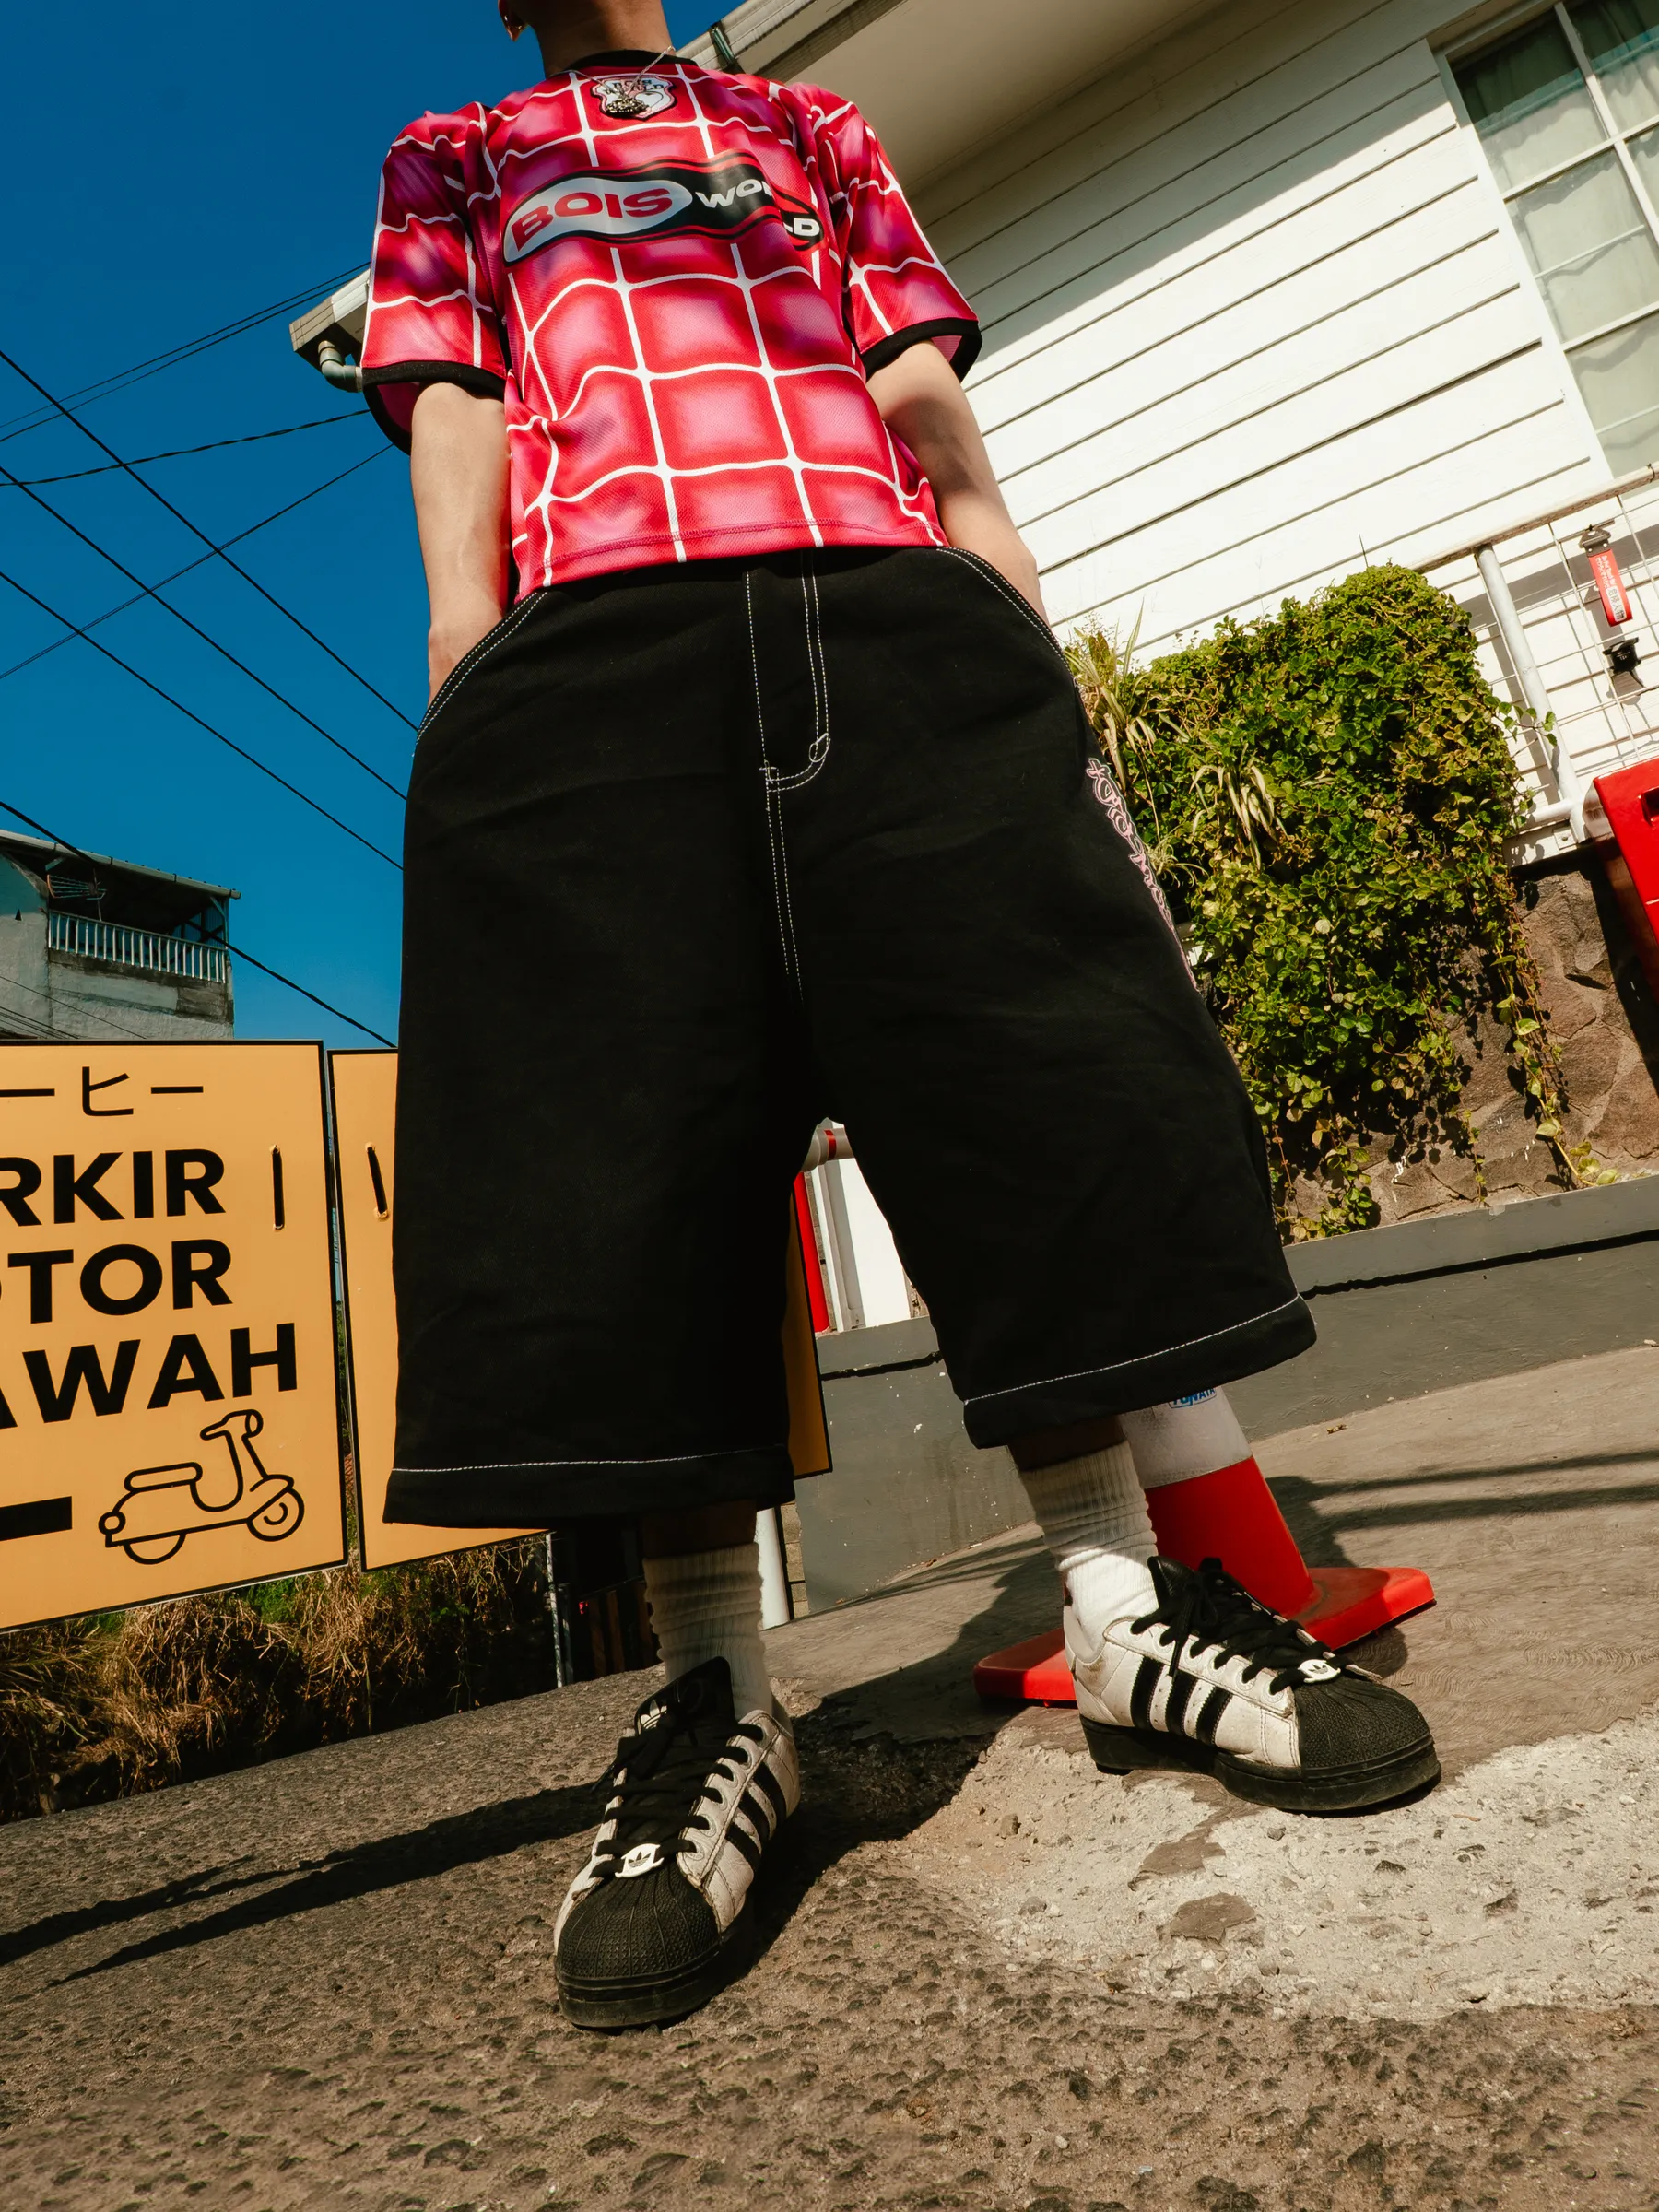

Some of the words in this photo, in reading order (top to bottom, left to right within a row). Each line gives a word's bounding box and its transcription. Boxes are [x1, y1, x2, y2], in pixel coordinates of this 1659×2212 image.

[511, 188, 673, 252] BOIS
[0, 1240, 233, 1324] TOR
[0, 1323, 298, 1430] WAH
